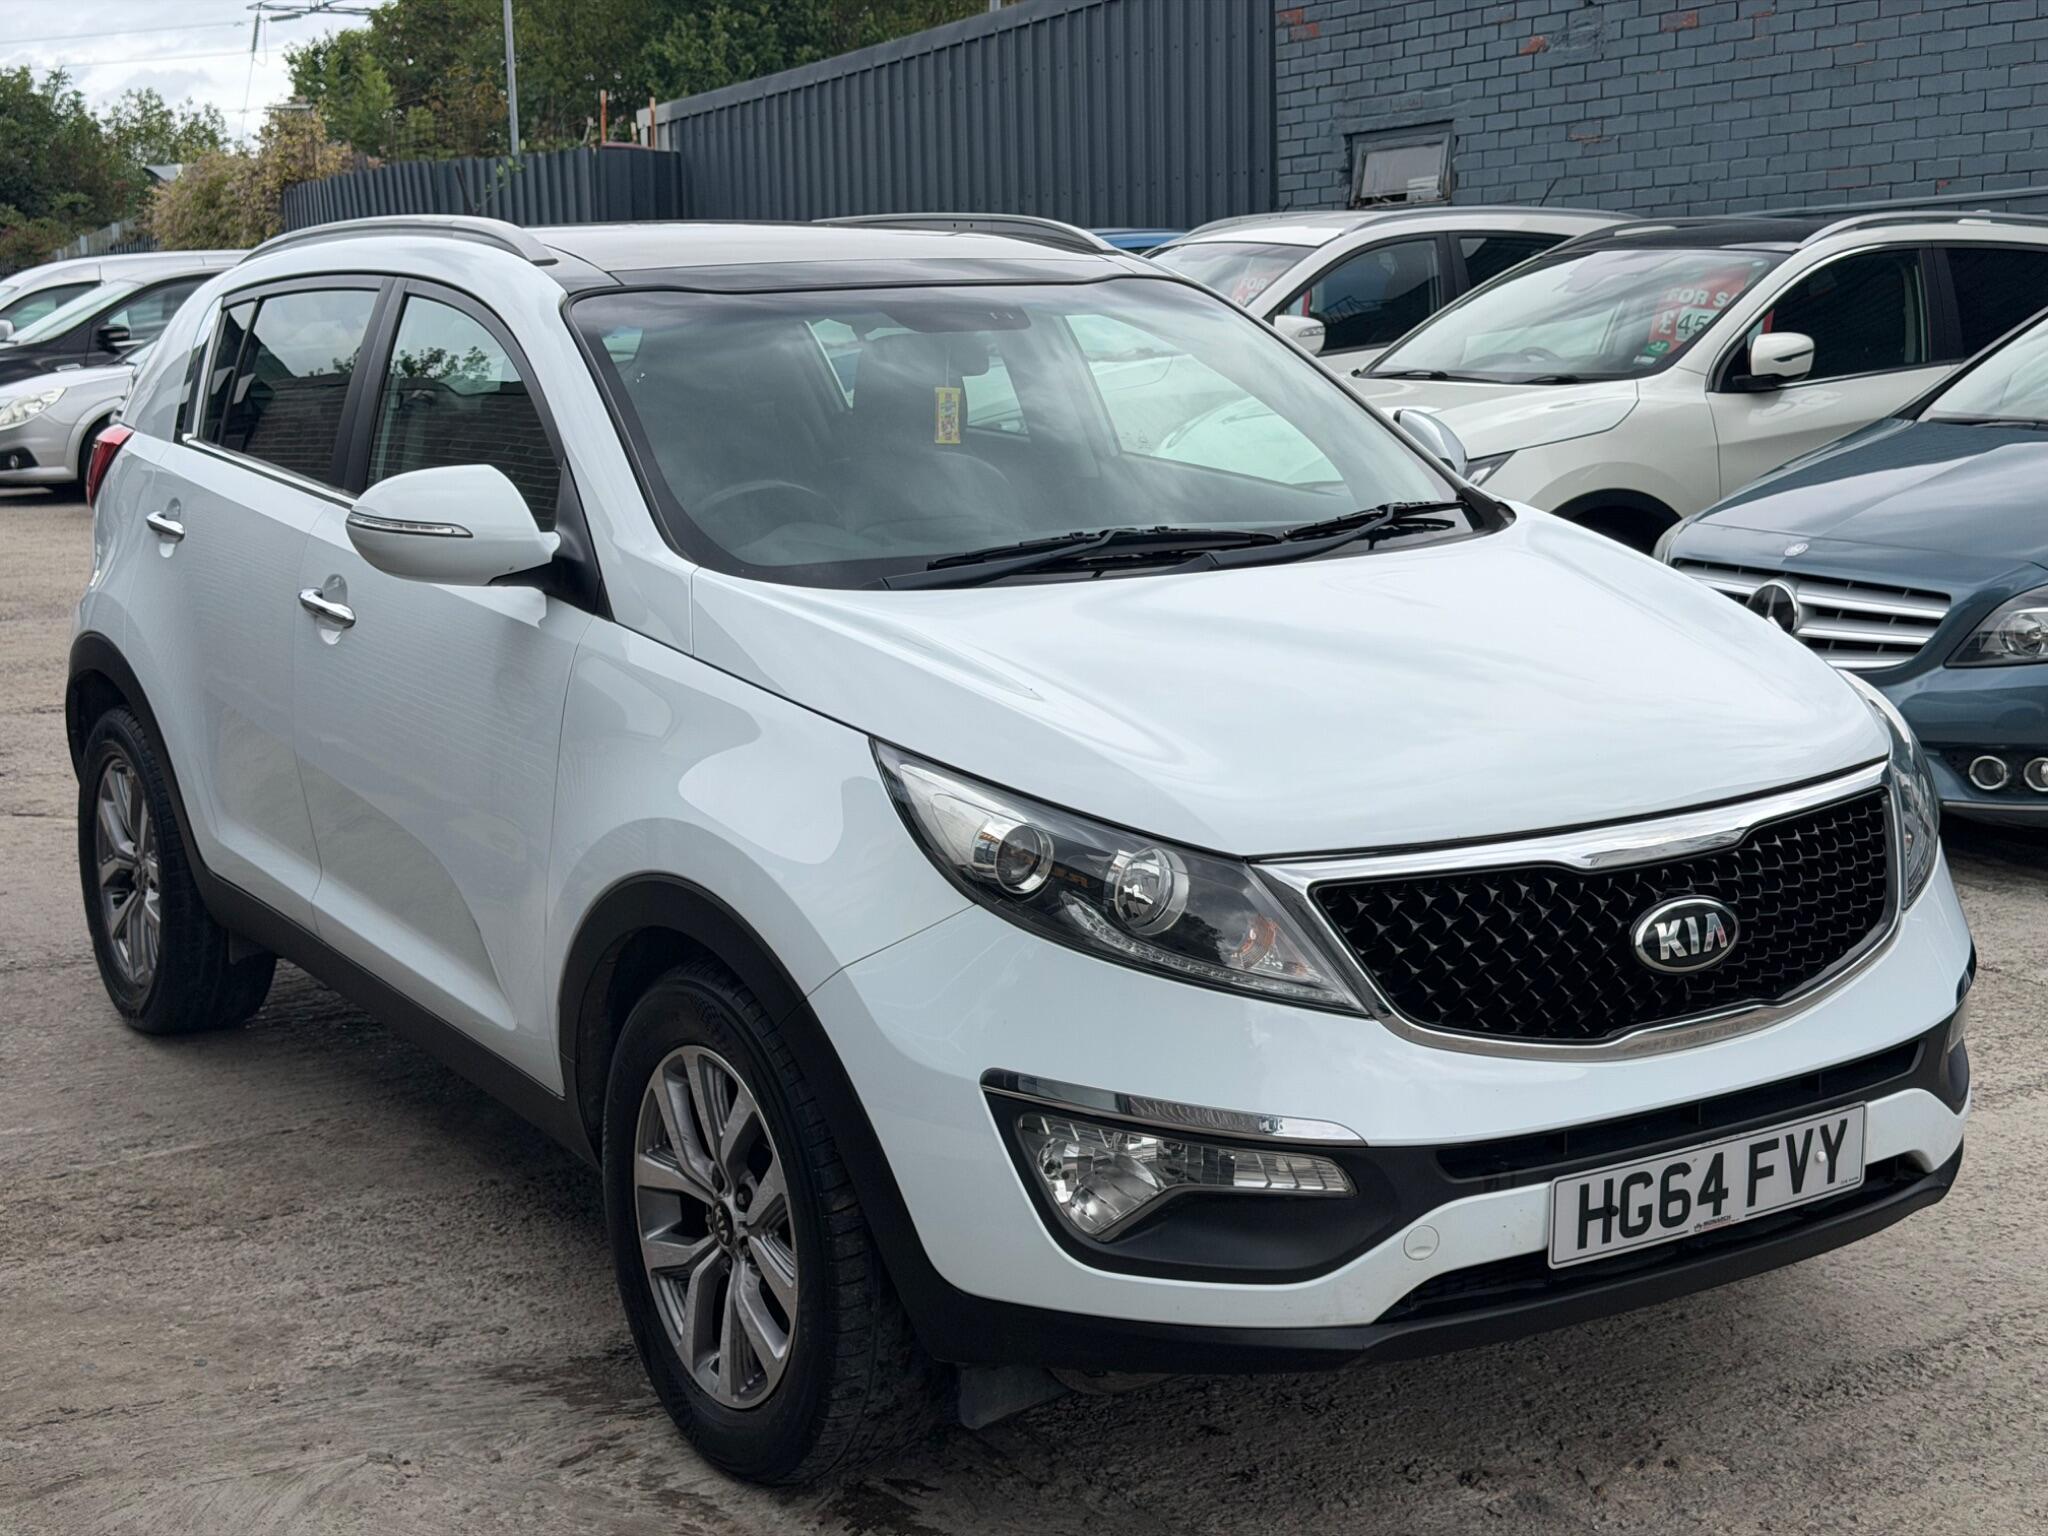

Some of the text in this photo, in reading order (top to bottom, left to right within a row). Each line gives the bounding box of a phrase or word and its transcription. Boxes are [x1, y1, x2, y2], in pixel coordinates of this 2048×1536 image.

[1667, 287, 1709, 305] FOR
[1655, 912, 1727, 960] KIA
[1577, 1118, 1848, 1250] HG64 FVY
